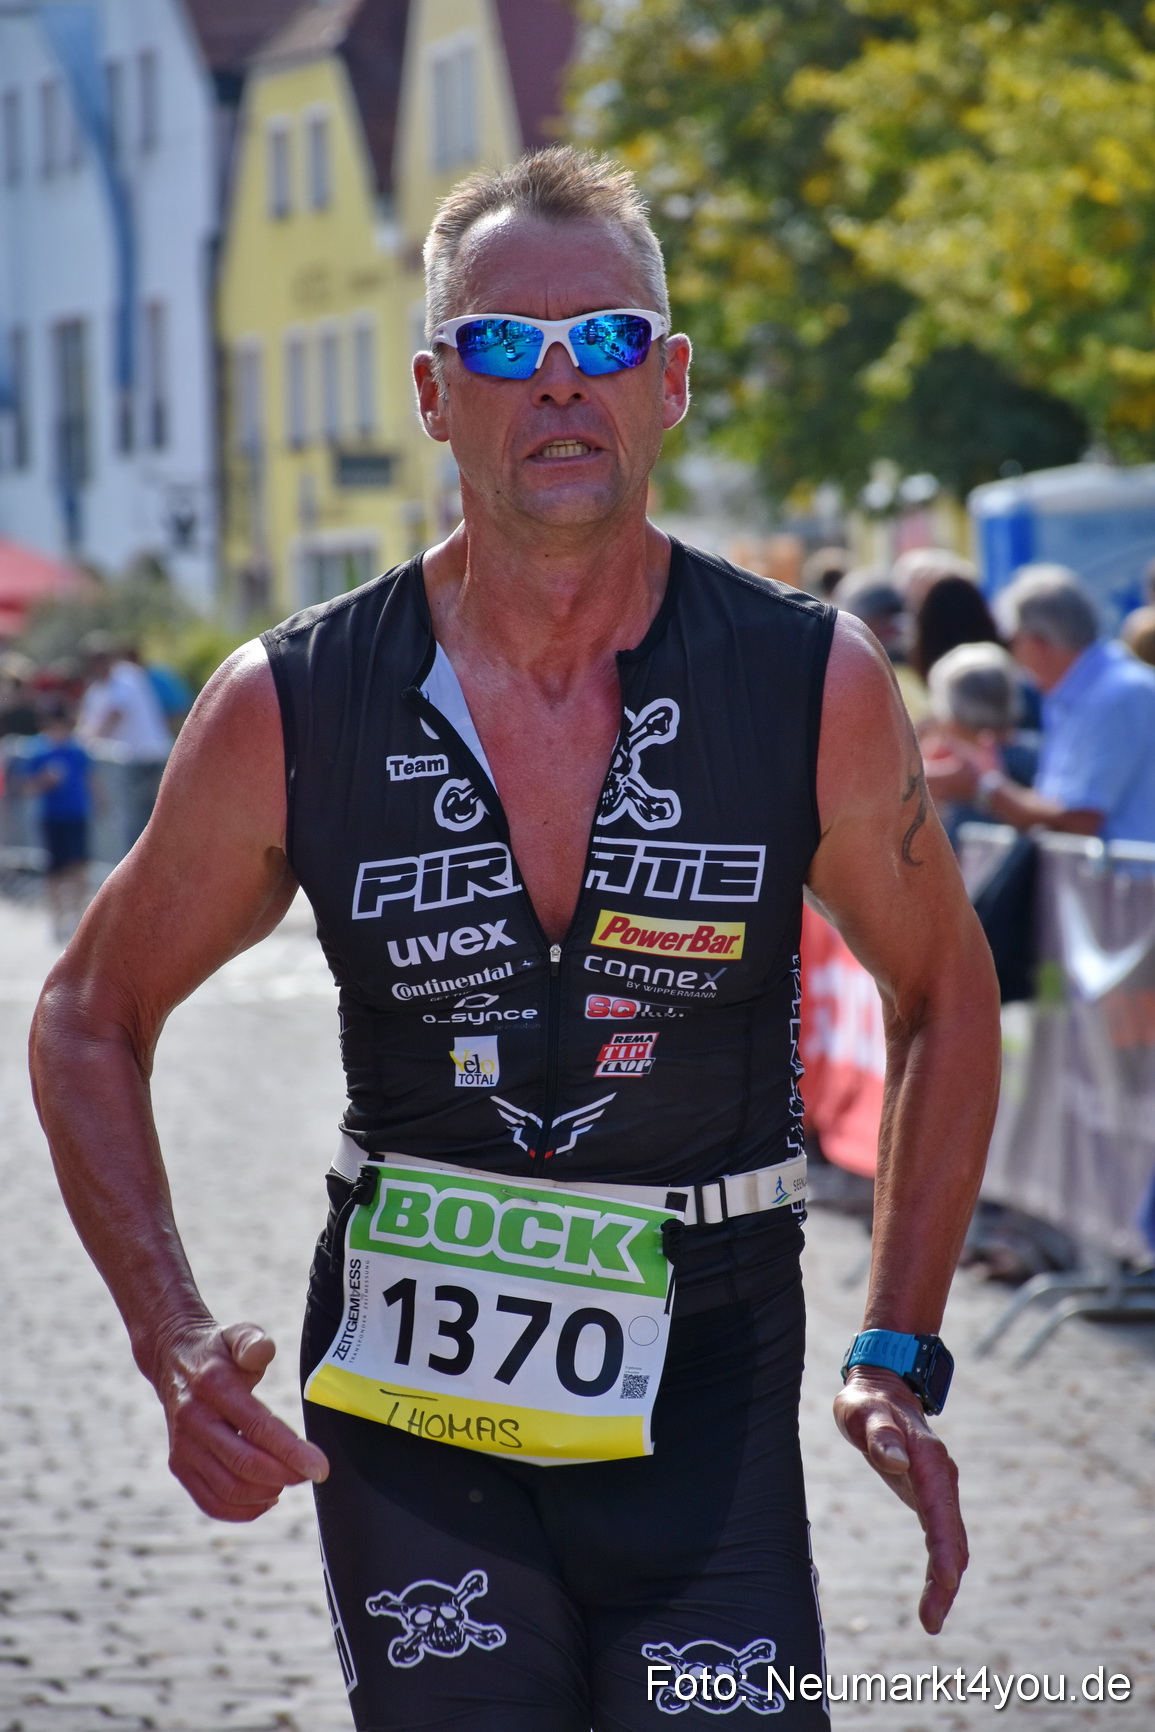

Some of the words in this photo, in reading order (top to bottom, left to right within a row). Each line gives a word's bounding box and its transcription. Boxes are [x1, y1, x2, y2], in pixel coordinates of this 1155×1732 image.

[388, 756, 447, 779] Team
[387, 919, 517, 967] uvex
[598, 915, 741, 955] PowerBar
[391, 962, 514, 1001] Continental
[626, 980, 641, 990] BY
[643, 985, 717, 999] WIPPERMANN
[603, 1045, 645, 1059] TIP
[613, 1034, 654, 1044] REMA
[458, 1073, 495, 1085] TOTAL
[605, 1060, 652, 1072] TOP
[374, 1187, 650, 1276] BOCK
[349, 1314, 367, 1363] TRANSPONDER
[382, 1277, 624, 1398] 1370
[379, 1388, 522, 1449] THOMAS
